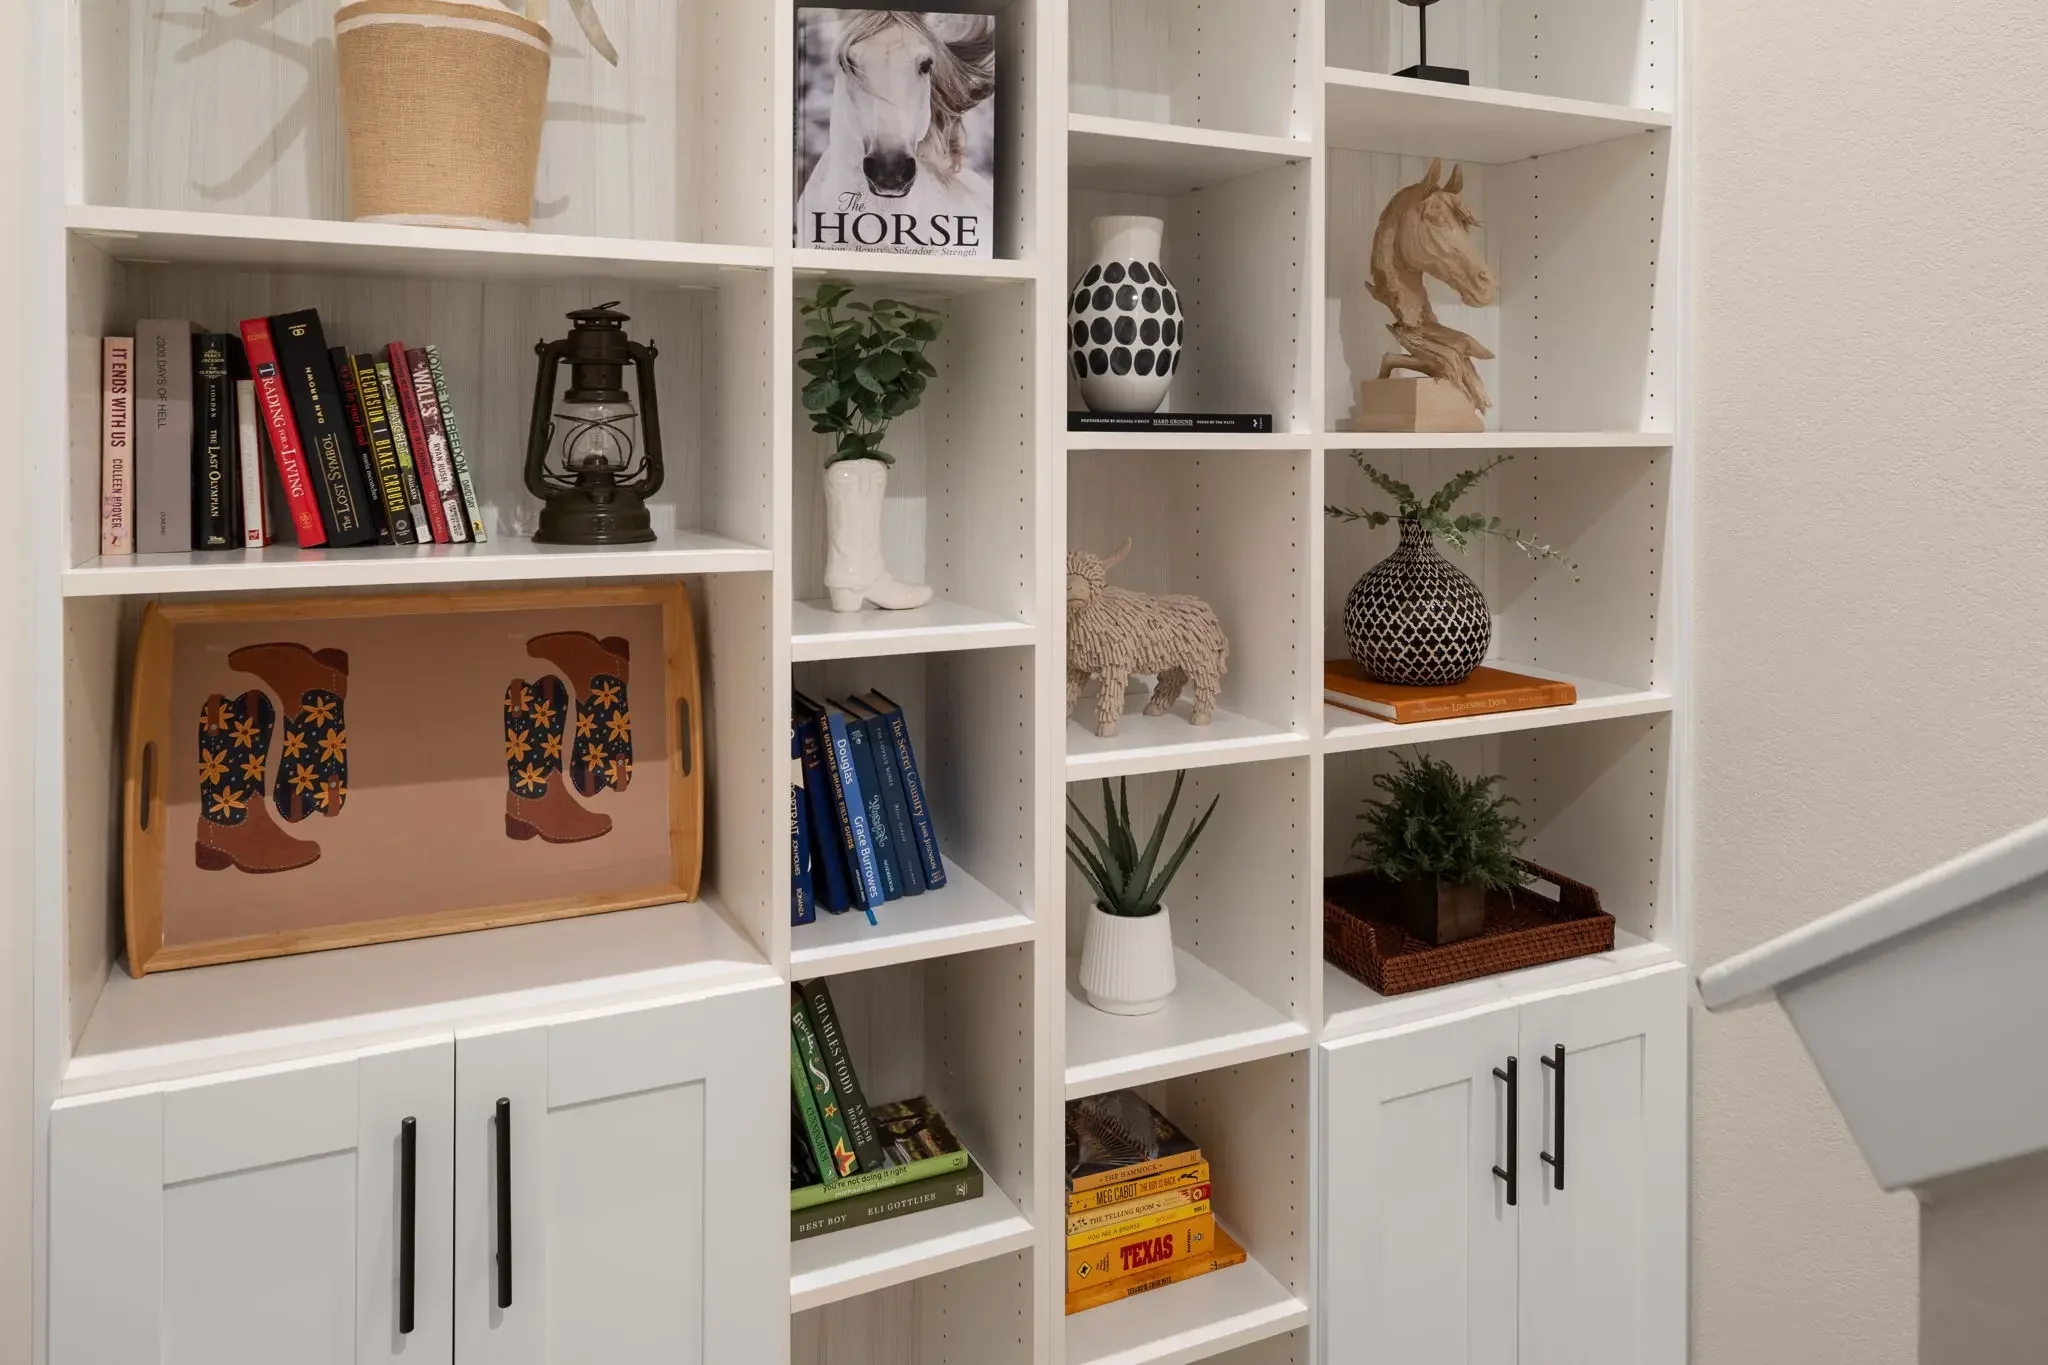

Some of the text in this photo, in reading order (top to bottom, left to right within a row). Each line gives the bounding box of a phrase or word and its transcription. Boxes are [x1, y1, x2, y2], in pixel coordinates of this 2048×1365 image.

[838, 192, 866, 212] The
[812, 212, 979, 246] HORSE
[894, 247, 932, 255] Splendor
[940, 248, 977, 257] Strength
[157, 360, 166, 385] DAYS
[111, 348, 127, 447] IT ENDS WITH US
[157, 390, 166, 402] OF
[305, 367, 324, 423] DAN BROWN
[360, 368, 384, 422] RECURSION
[413, 369, 437, 417] WALLS
[428, 347, 468, 474] VOYAGE TO FREEDOM
[158, 405, 167, 429] HELL
[260, 364, 285, 427] TRADING
[282, 448, 304, 498] LIVING
[388, 404, 409, 455] HATCHET
[208, 446, 220, 469] LAST
[375, 439, 396, 470] BLAKE
[433, 443, 448, 482] RYAN RUSH
[112, 458, 122, 528] COLLEEN HOOVER
[209, 471, 221, 517] OLYMPIAN
[322, 434, 352, 531] The LOST SYMBOL
[384, 474, 405, 512] CROUCH
[1488, 698, 1506, 708] DOVE
[837, 739, 853, 784] Douglas
[892, 718, 923, 816] The Secret Country
[824, 734, 836, 771] ULTIMATE
[832, 773, 843, 800] SHARK
[840, 802, 848, 824] FIELD
[844, 825, 855, 850] GUIDE
[854, 816, 866, 846] Grace
[862, 847, 878, 898] Burrowes
[923, 838, 936, 869] JOHNSON
[815, 994, 841, 1056] CHARLES
[835, 1057, 853, 1093] TODD
[806, 1107, 828, 1161] CUNNINGHAM
[848, 1108, 864, 1147] HOSTAGE
[860, 1117, 872, 1142] IRISH
[823, 1167, 907, 1193] you're not doing it right
[1104, 1164, 1158, 1182] THE HAMMOCK
[800, 1193, 936, 1232] BEST BOY ELI GOTTLIEB
[1096, 1189, 1112, 1205] MEG
[1114, 1183, 1138, 1201] CABOT
[1089, 1203, 1154, 1225] THE TELLING ROOM
[1118, 1223, 1140, 1233] BADASS
[1120, 1234, 1173, 1270] TEXAS
